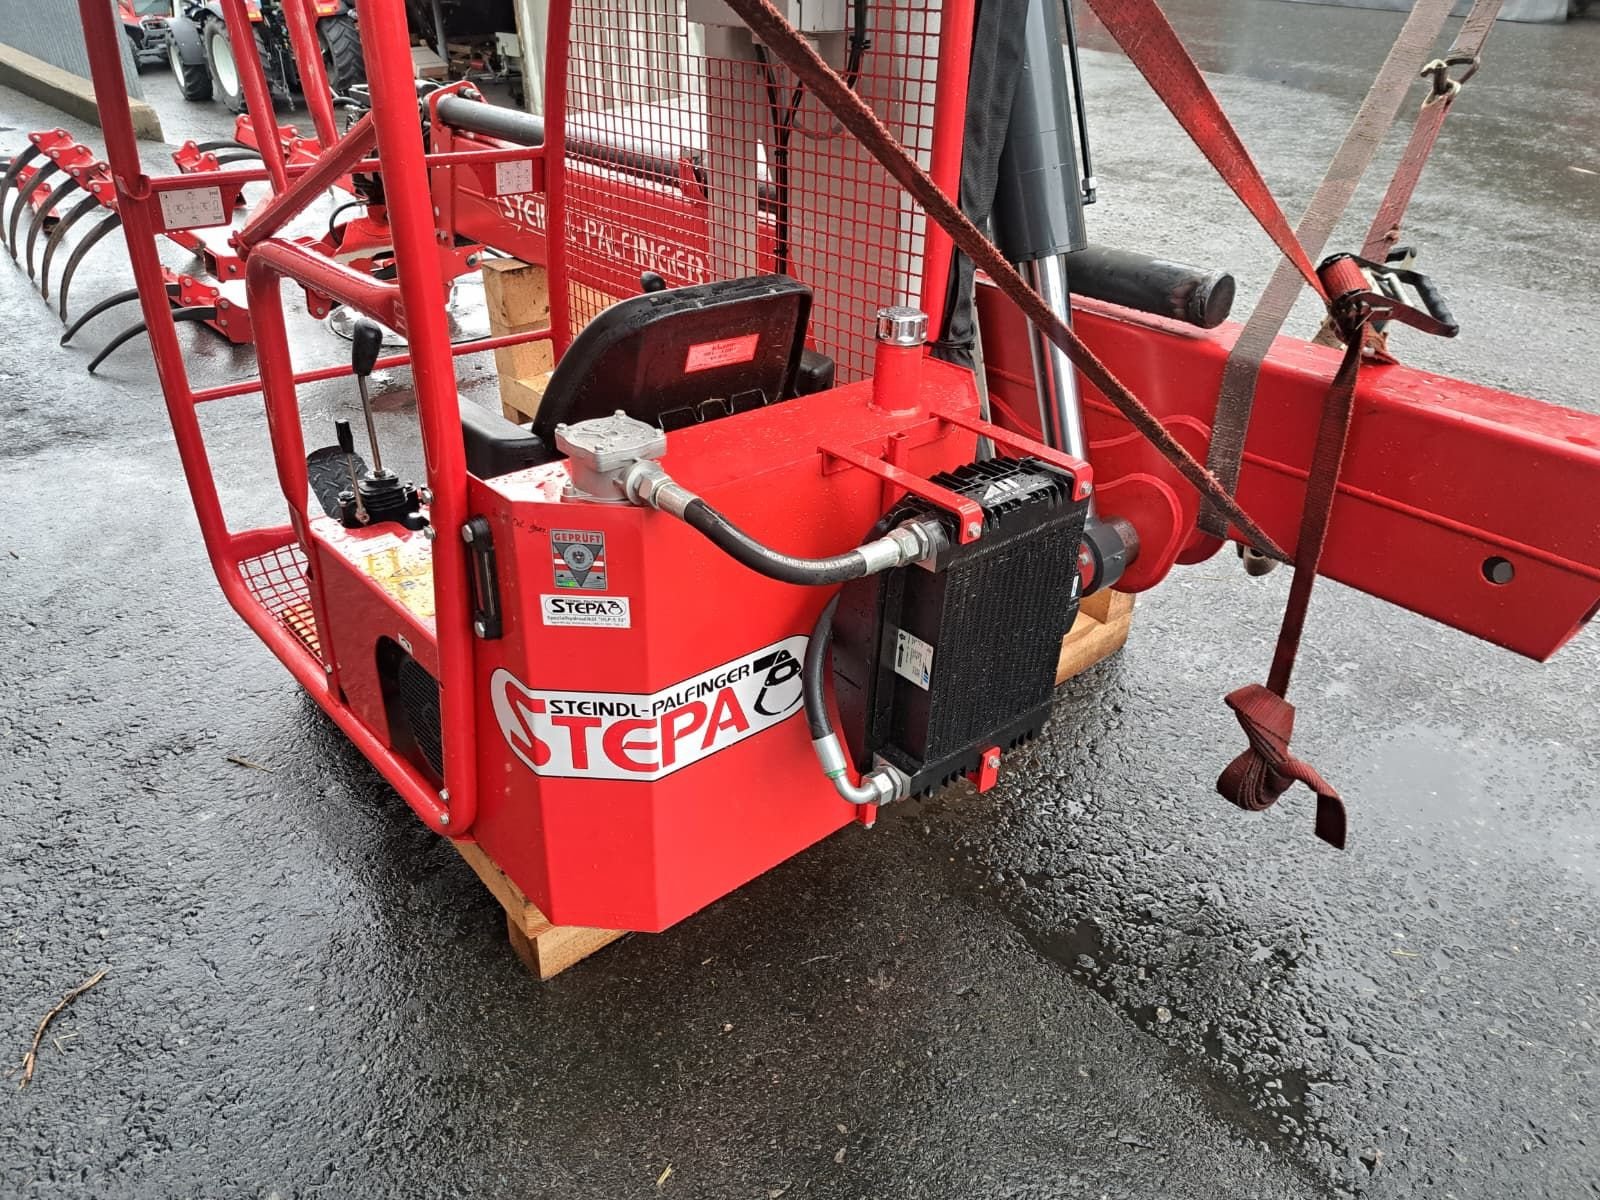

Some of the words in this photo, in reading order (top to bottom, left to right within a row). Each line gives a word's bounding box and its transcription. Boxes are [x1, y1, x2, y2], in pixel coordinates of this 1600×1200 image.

[554, 532, 601, 543] GEPRÜFT
[551, 598, 608, 615] STEPA
[549, 664, 750, 718] STEINDL-PALFINGER
[504, 681, 751, 773] STEPA
